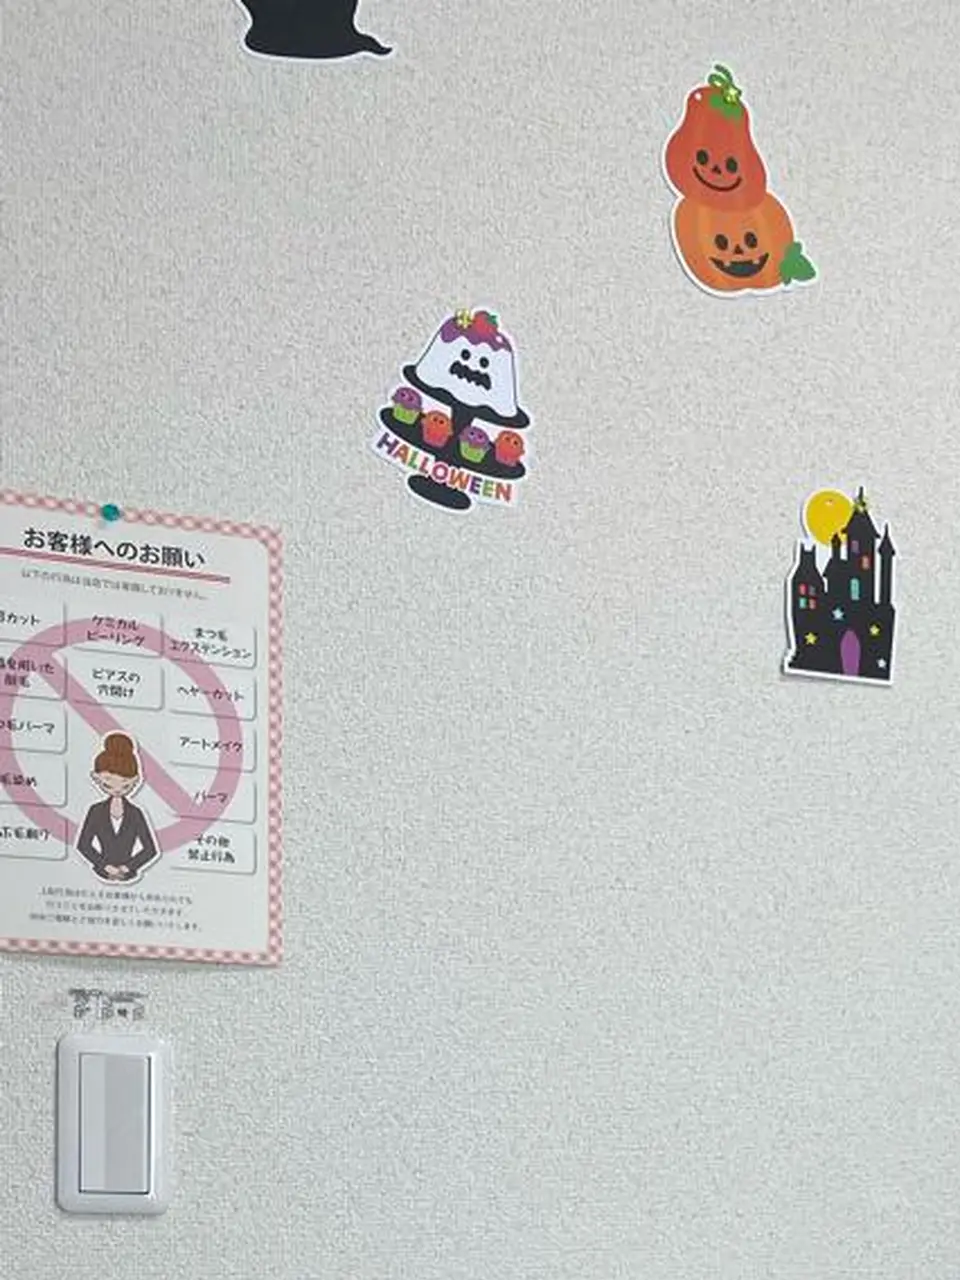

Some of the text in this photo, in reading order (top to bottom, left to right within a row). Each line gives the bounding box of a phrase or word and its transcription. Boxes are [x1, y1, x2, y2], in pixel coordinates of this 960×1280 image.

[376, 431, 513, 502] HALLOWEEN
[23, 527, 206, 569] お客様へのお願い
[91, 614, 141, 632] ケミカル
[86, 630, 145, 647] ピーリング
[194, 627, 228, 642] まつ毛
[170, 639, 252, 660] エクステンション
[92, 667, 141, 684] ピアスの
[97, 685, 135, 699] 穴開け
[179, 736, 243, 752] アートメイク
[196, 836, 231, 849] その他
[187, 849, 236, 864] 禁止行為
